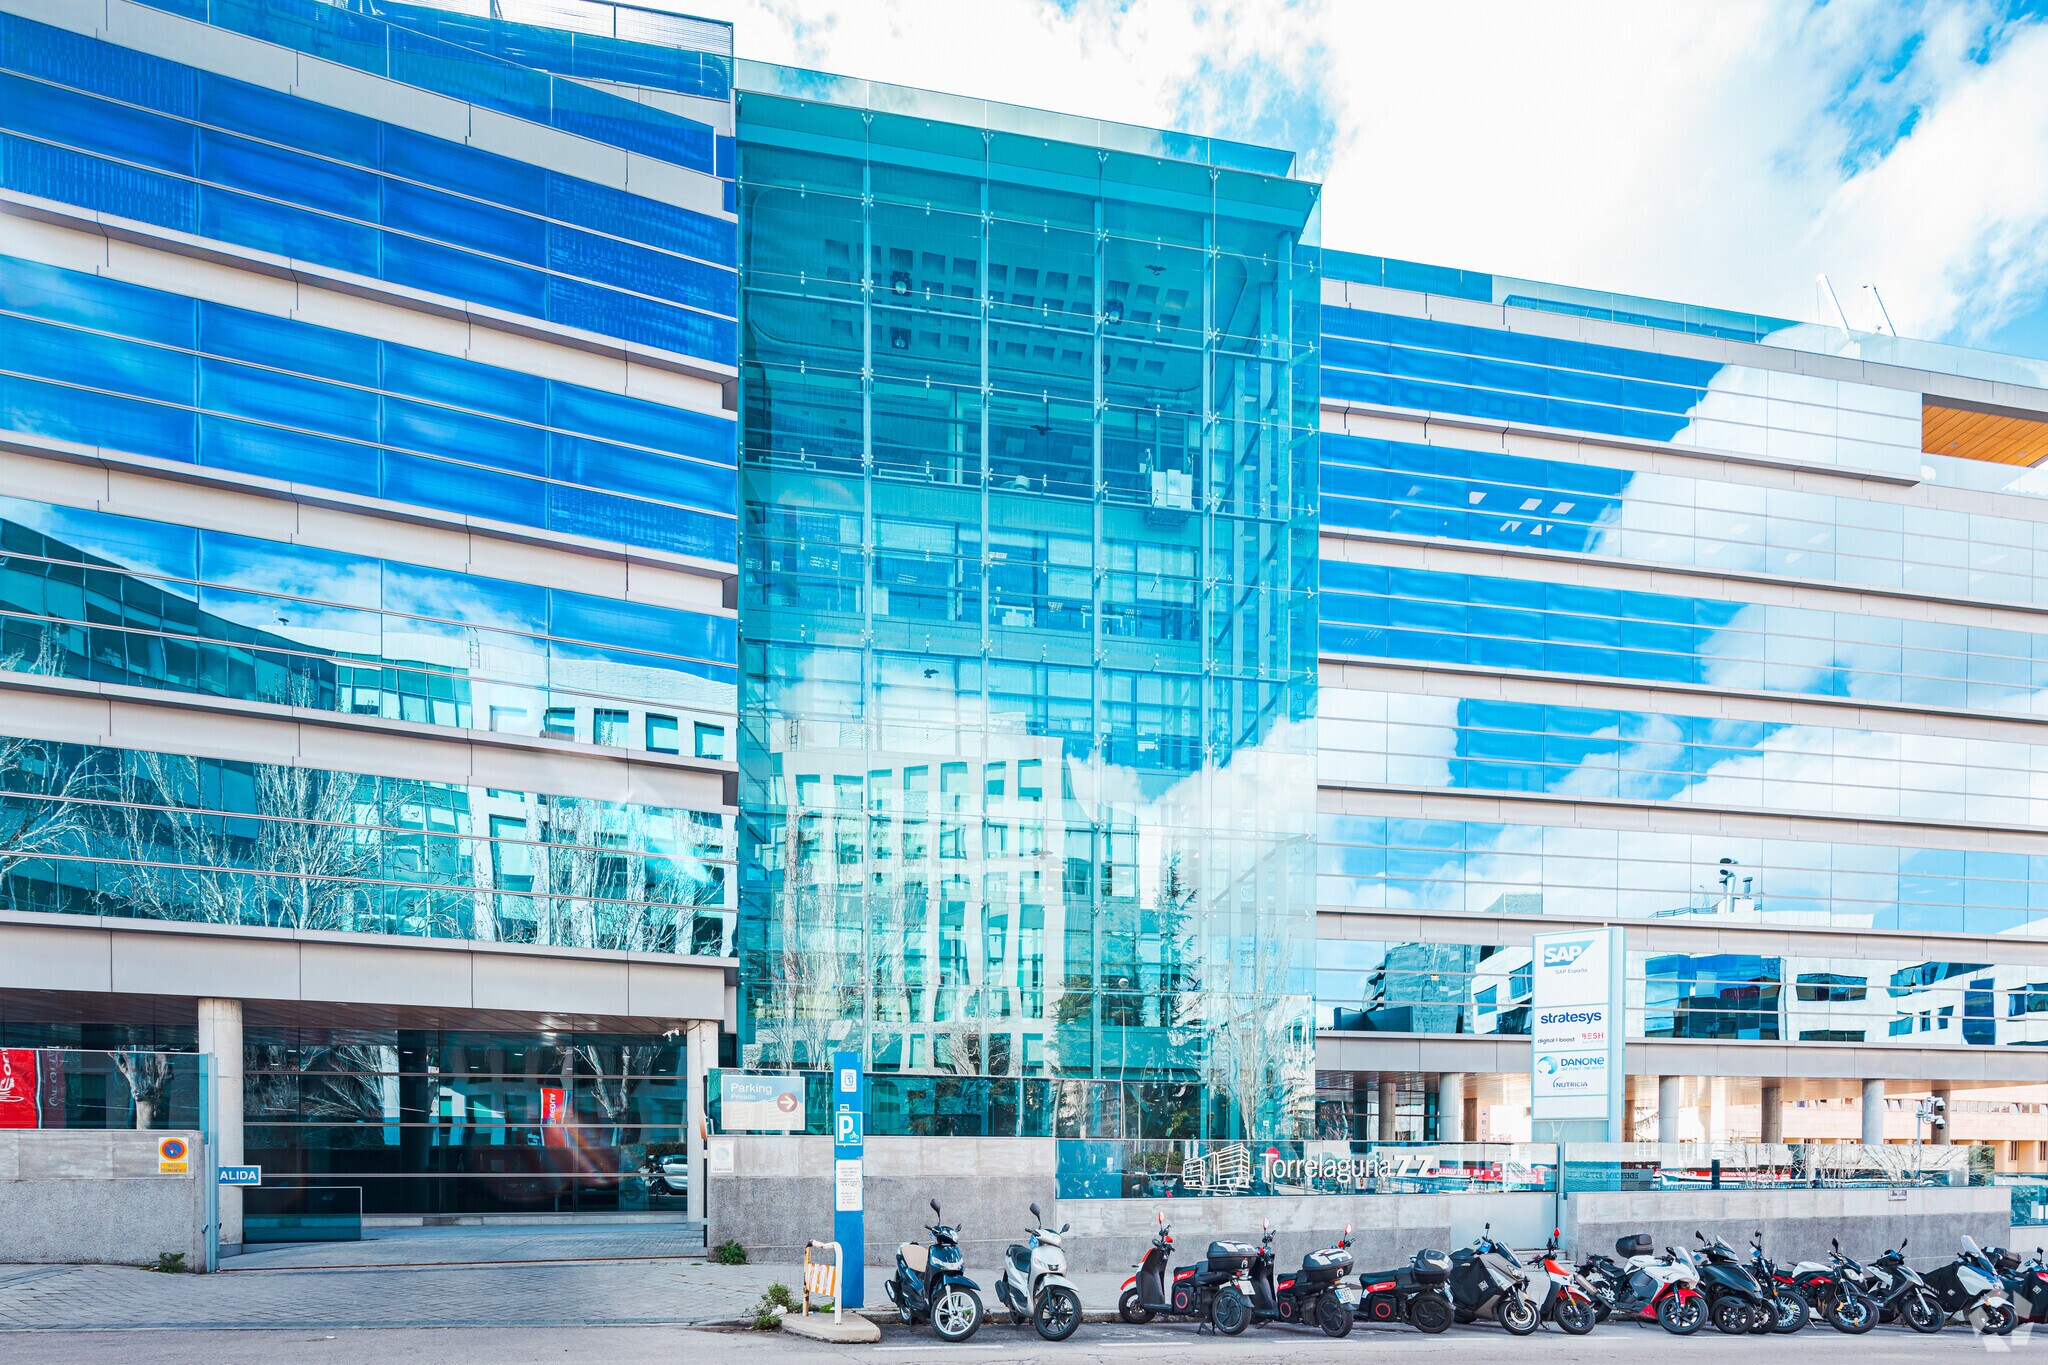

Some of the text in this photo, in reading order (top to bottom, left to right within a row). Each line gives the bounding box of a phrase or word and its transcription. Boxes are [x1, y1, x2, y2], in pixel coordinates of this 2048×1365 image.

[1544, 945, 1582, 964] SAP
[1568, 967, 1588, 975] España
[1540, 1012, 1602, 1025] stratesys
[1537, 1037, 1555, 1045] digital
[730, 1083, 773, 1095] Parking
[839, 1115, 854, 1142] P
[1260, 1153, 1391, 1184] Torrelaguna
[219, 1170, 257, 1181] ALIDA
